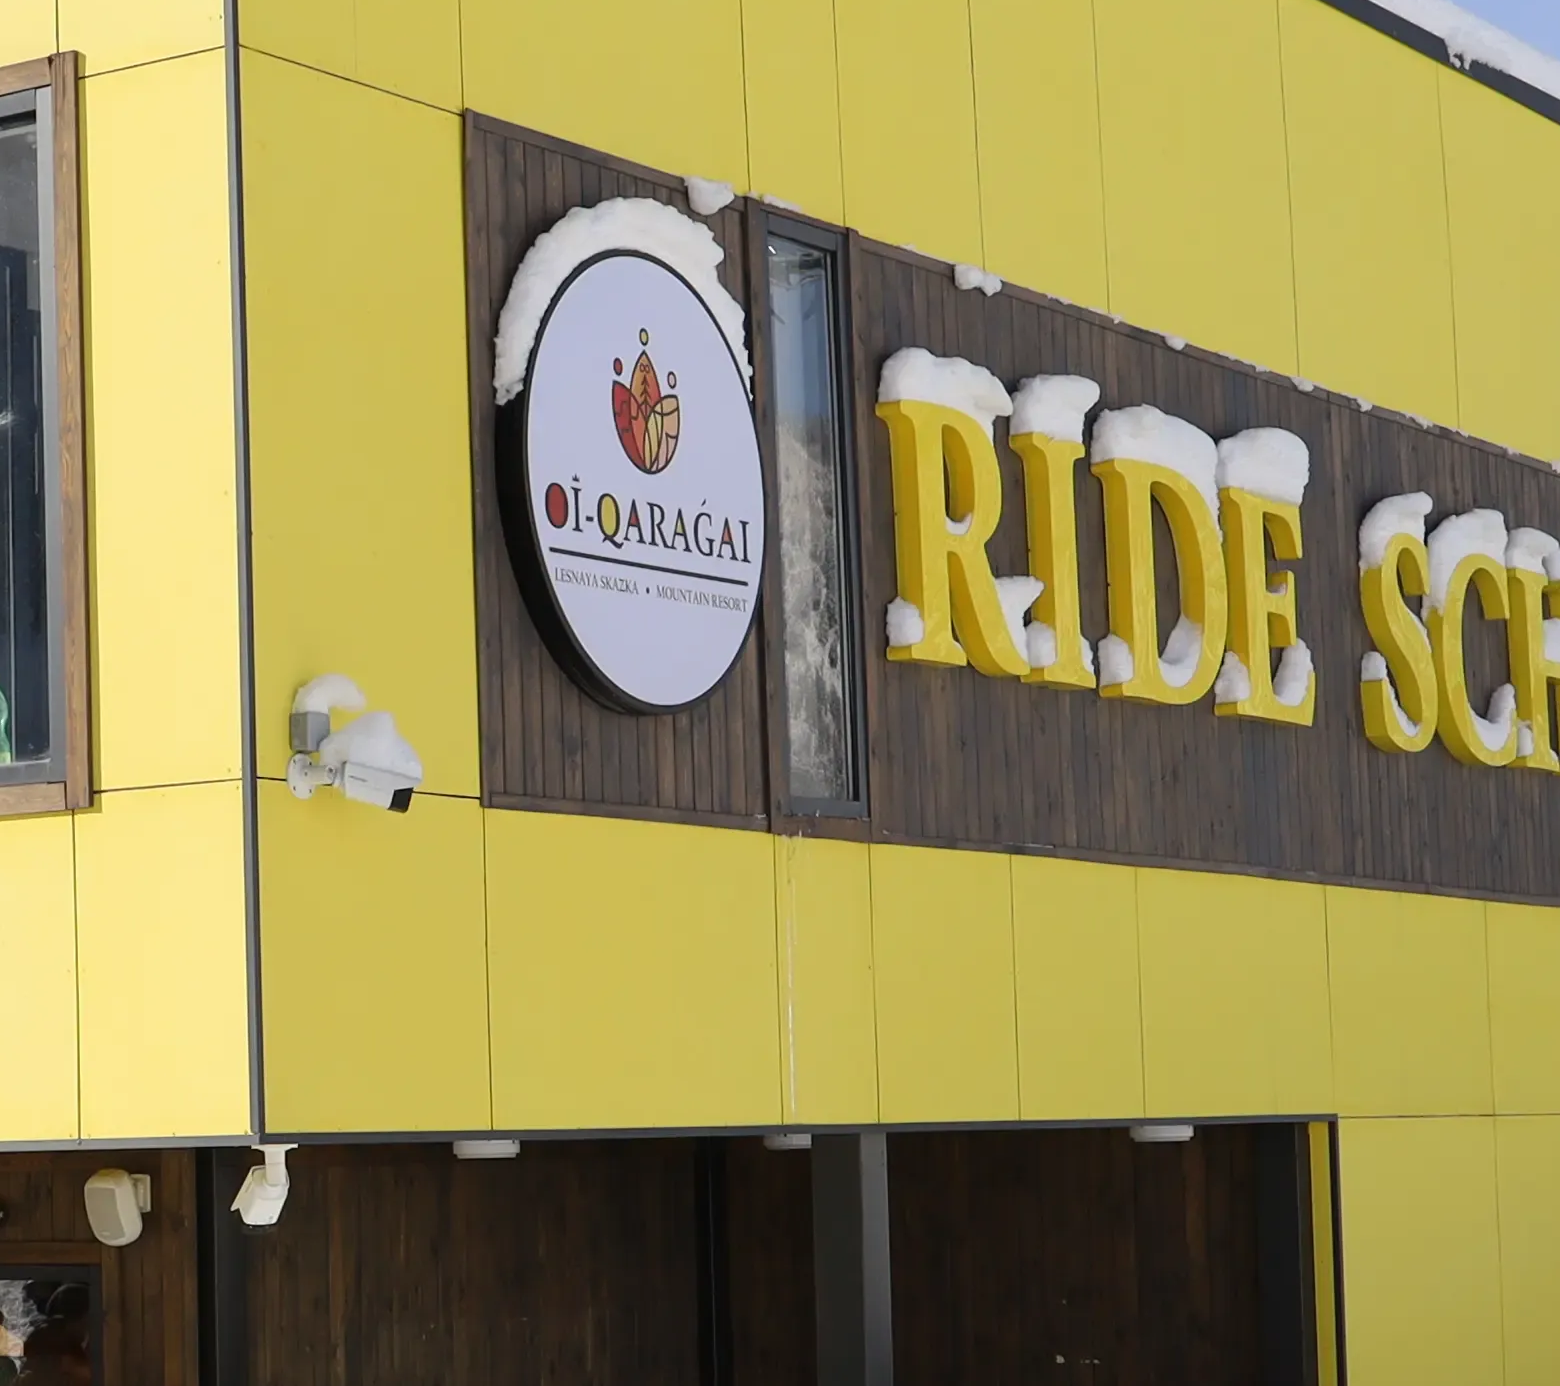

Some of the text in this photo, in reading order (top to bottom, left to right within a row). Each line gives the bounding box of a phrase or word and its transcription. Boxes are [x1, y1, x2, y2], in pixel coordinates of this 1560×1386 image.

[554, 566, 748, 613] LESNAYA SKAZKA MOUNTAIN RESORT
[876, 399, 1316, 727] RIDE
